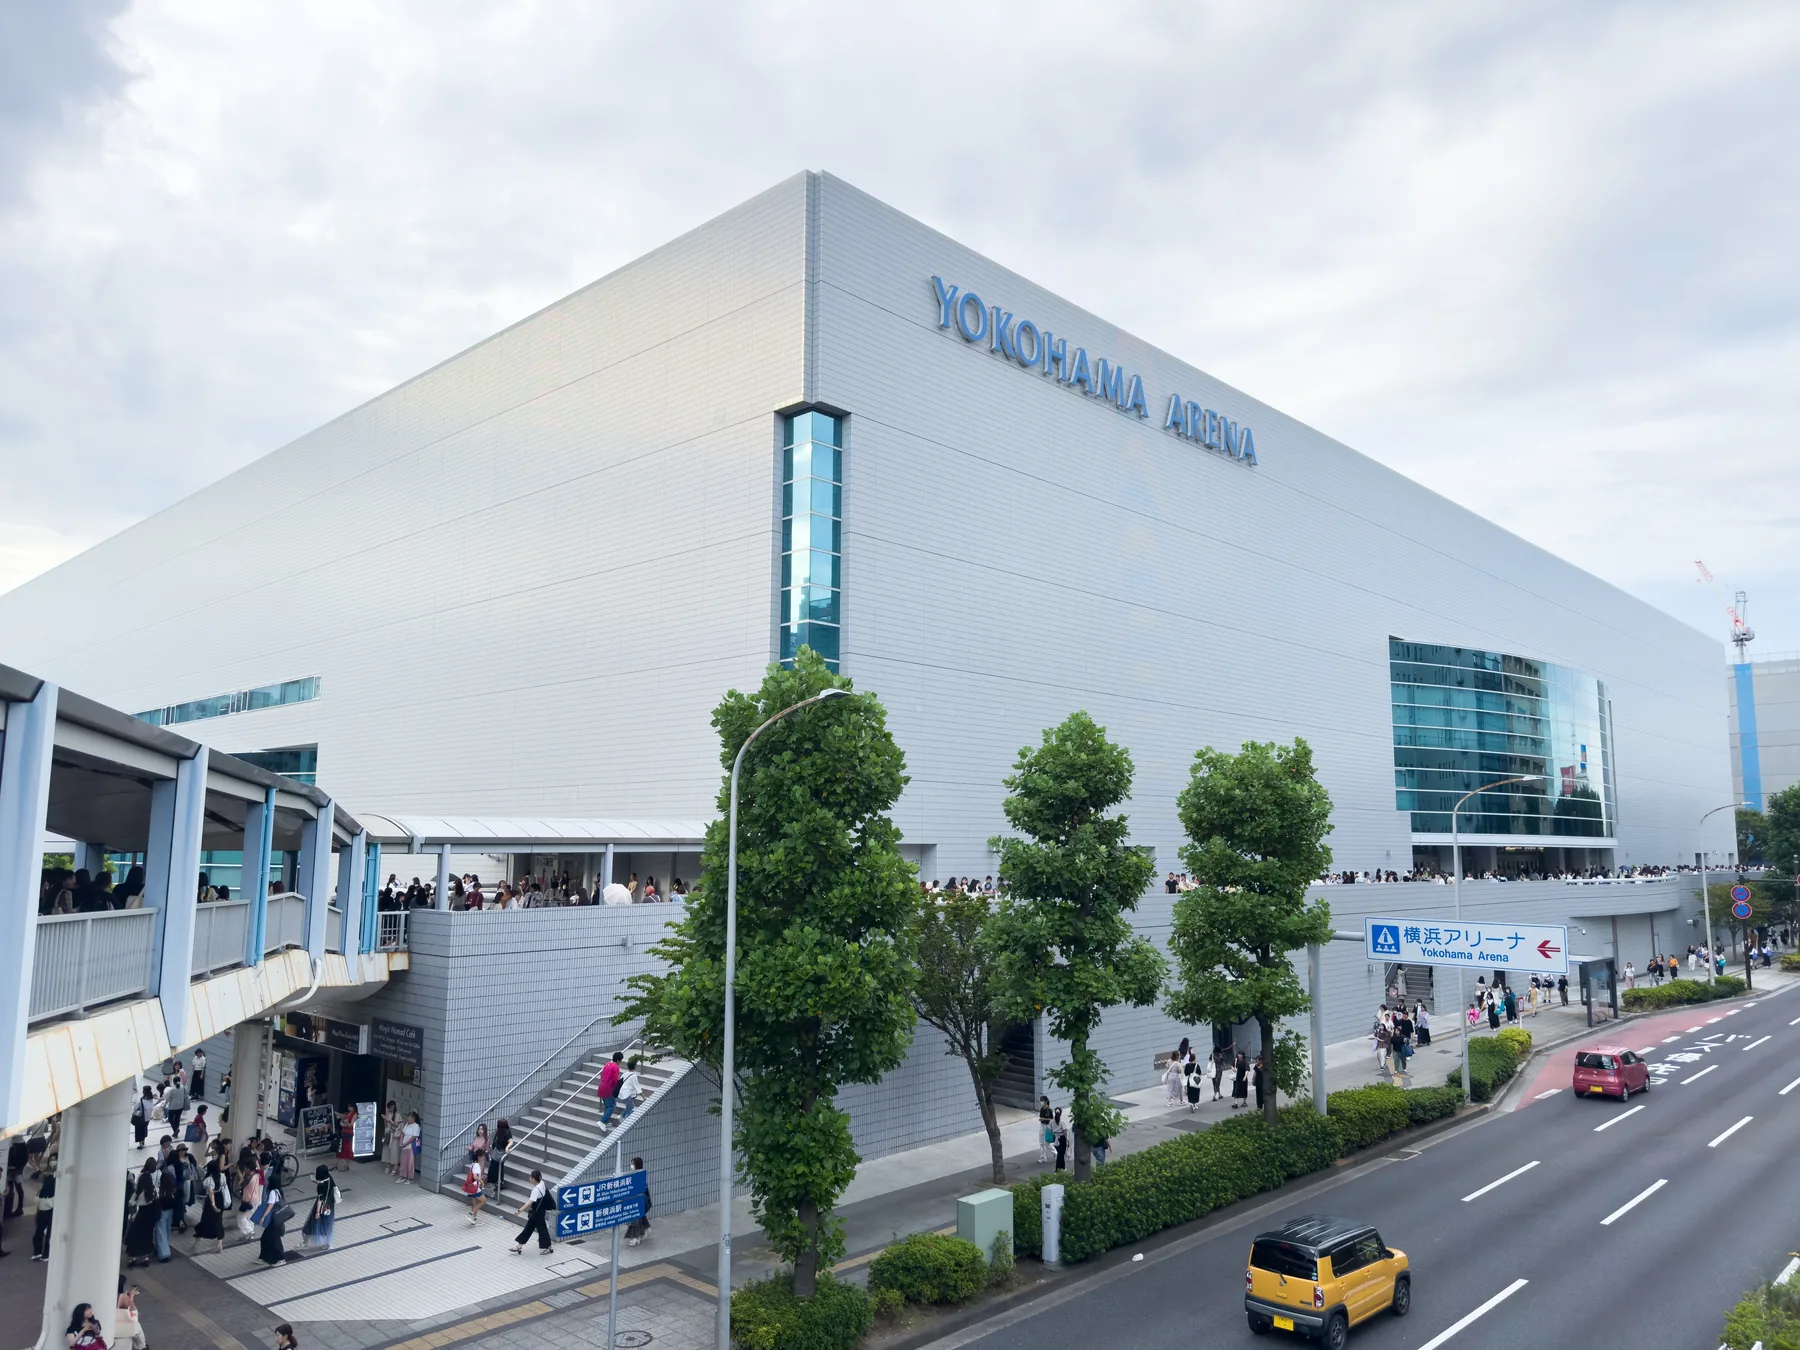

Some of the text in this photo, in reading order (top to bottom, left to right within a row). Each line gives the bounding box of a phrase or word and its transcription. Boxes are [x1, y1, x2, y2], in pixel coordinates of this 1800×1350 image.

[930, 275, 1258, 466] YOKOHAMA ARENA
[1403, 926, 1526, 950] 横浜アリーナ
[1421, 947, 1509, 962] Yokohama Arena
[596, 1176, 632, 1192] JR新横浜駅
[595, 1204, 622, 1218] 新横浜駅
